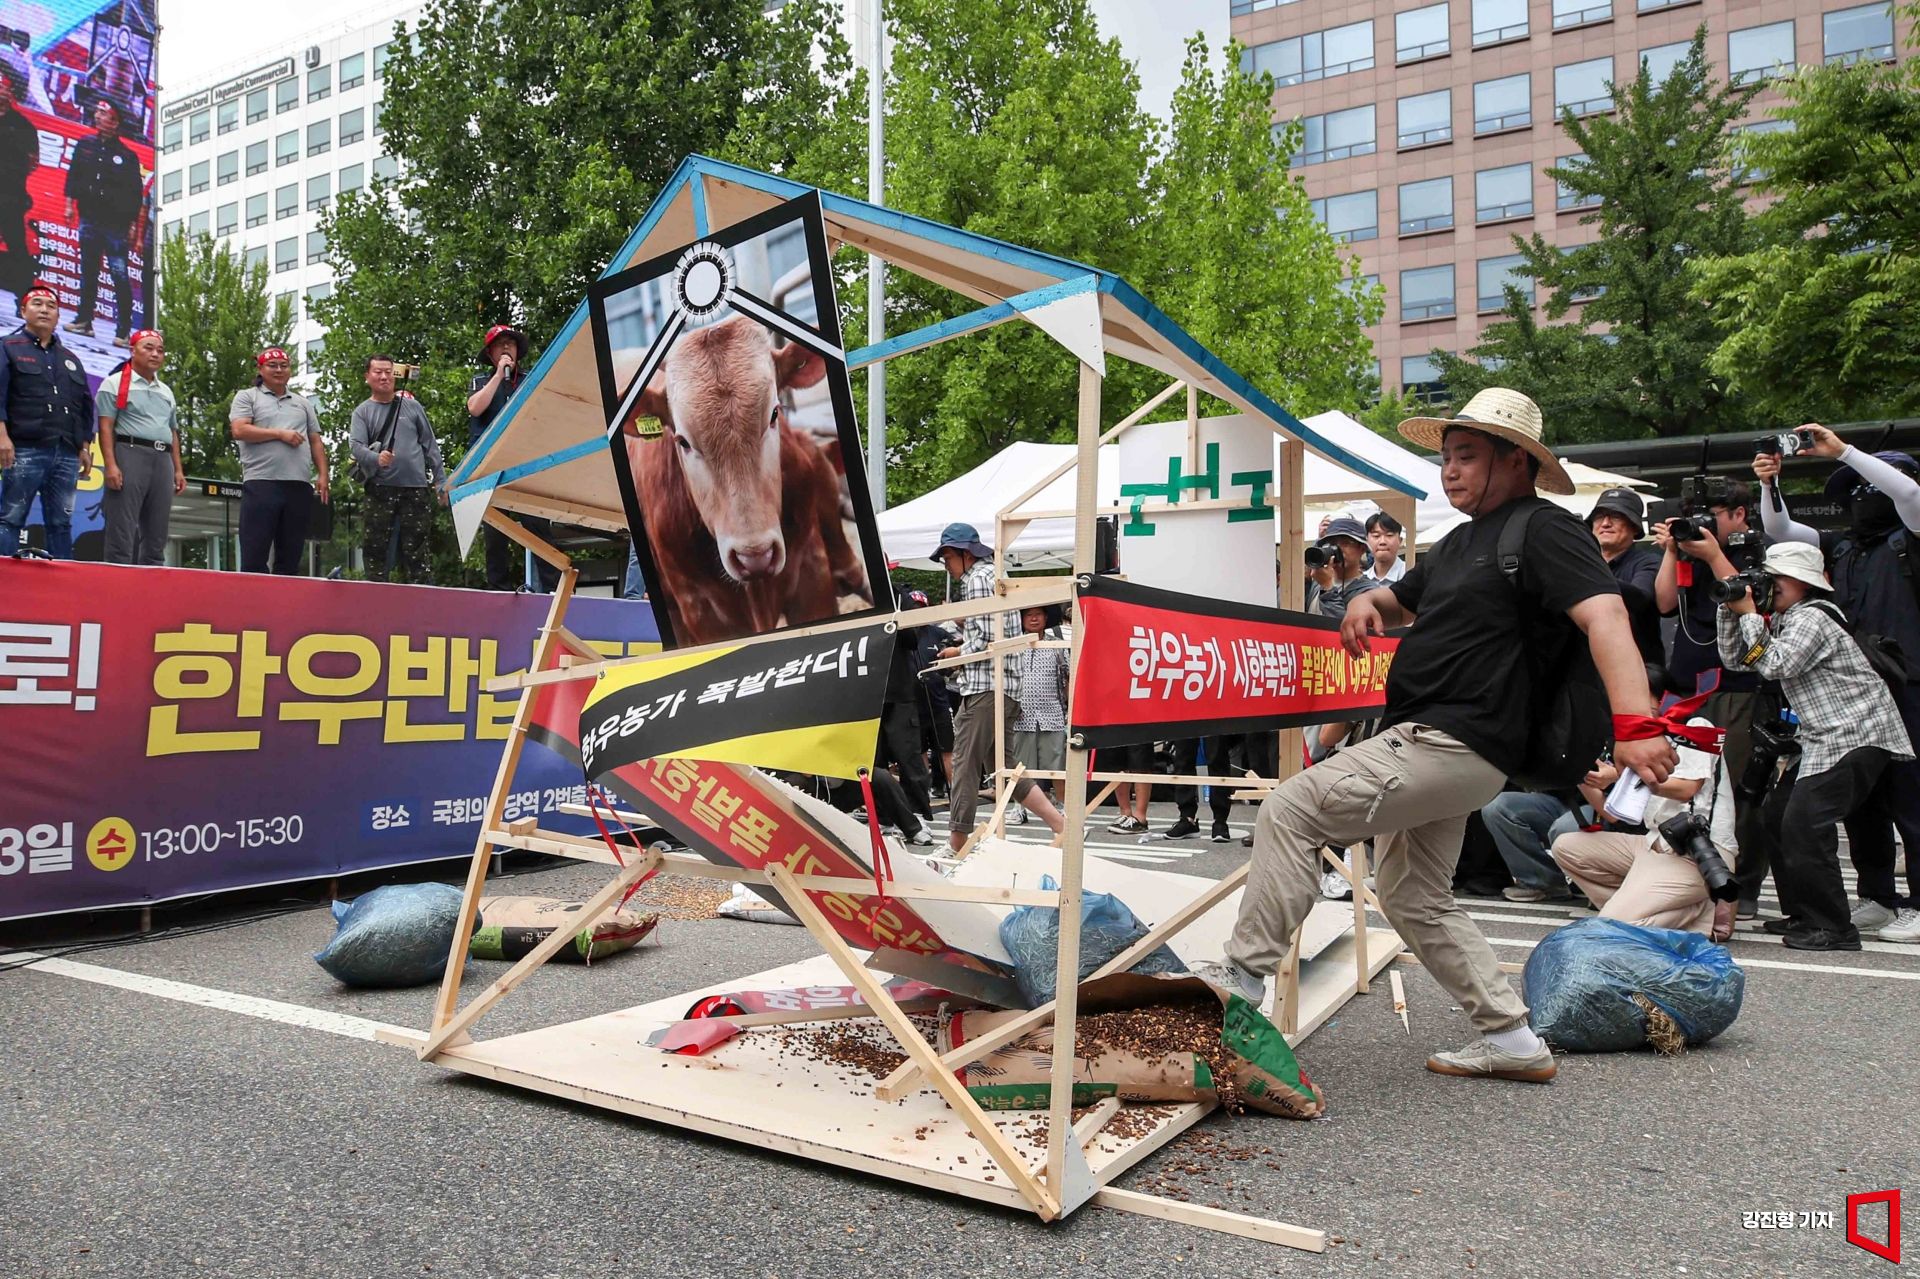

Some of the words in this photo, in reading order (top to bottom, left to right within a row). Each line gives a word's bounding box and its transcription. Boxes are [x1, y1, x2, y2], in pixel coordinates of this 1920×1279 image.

[215, 79, 244, 101] Hyundai
[244, 63, 288, 88] Commercial
[1129, 626, 1226, 700] 한우농가
[1230, 638, 1297, 699] 시한폭탄!
[1301, 646, 1346, 696] 폭발전에
[580, 689, 687, 775] 한우농가
[696, 636, 870, 705] 폭발한다!
[371, 804, 410, 831] 장소
[432, 790, 540, 826] 국회의당역
[97, 828, 126, 861] 수
[141, 815, 304, 862] 13:00~15:30
